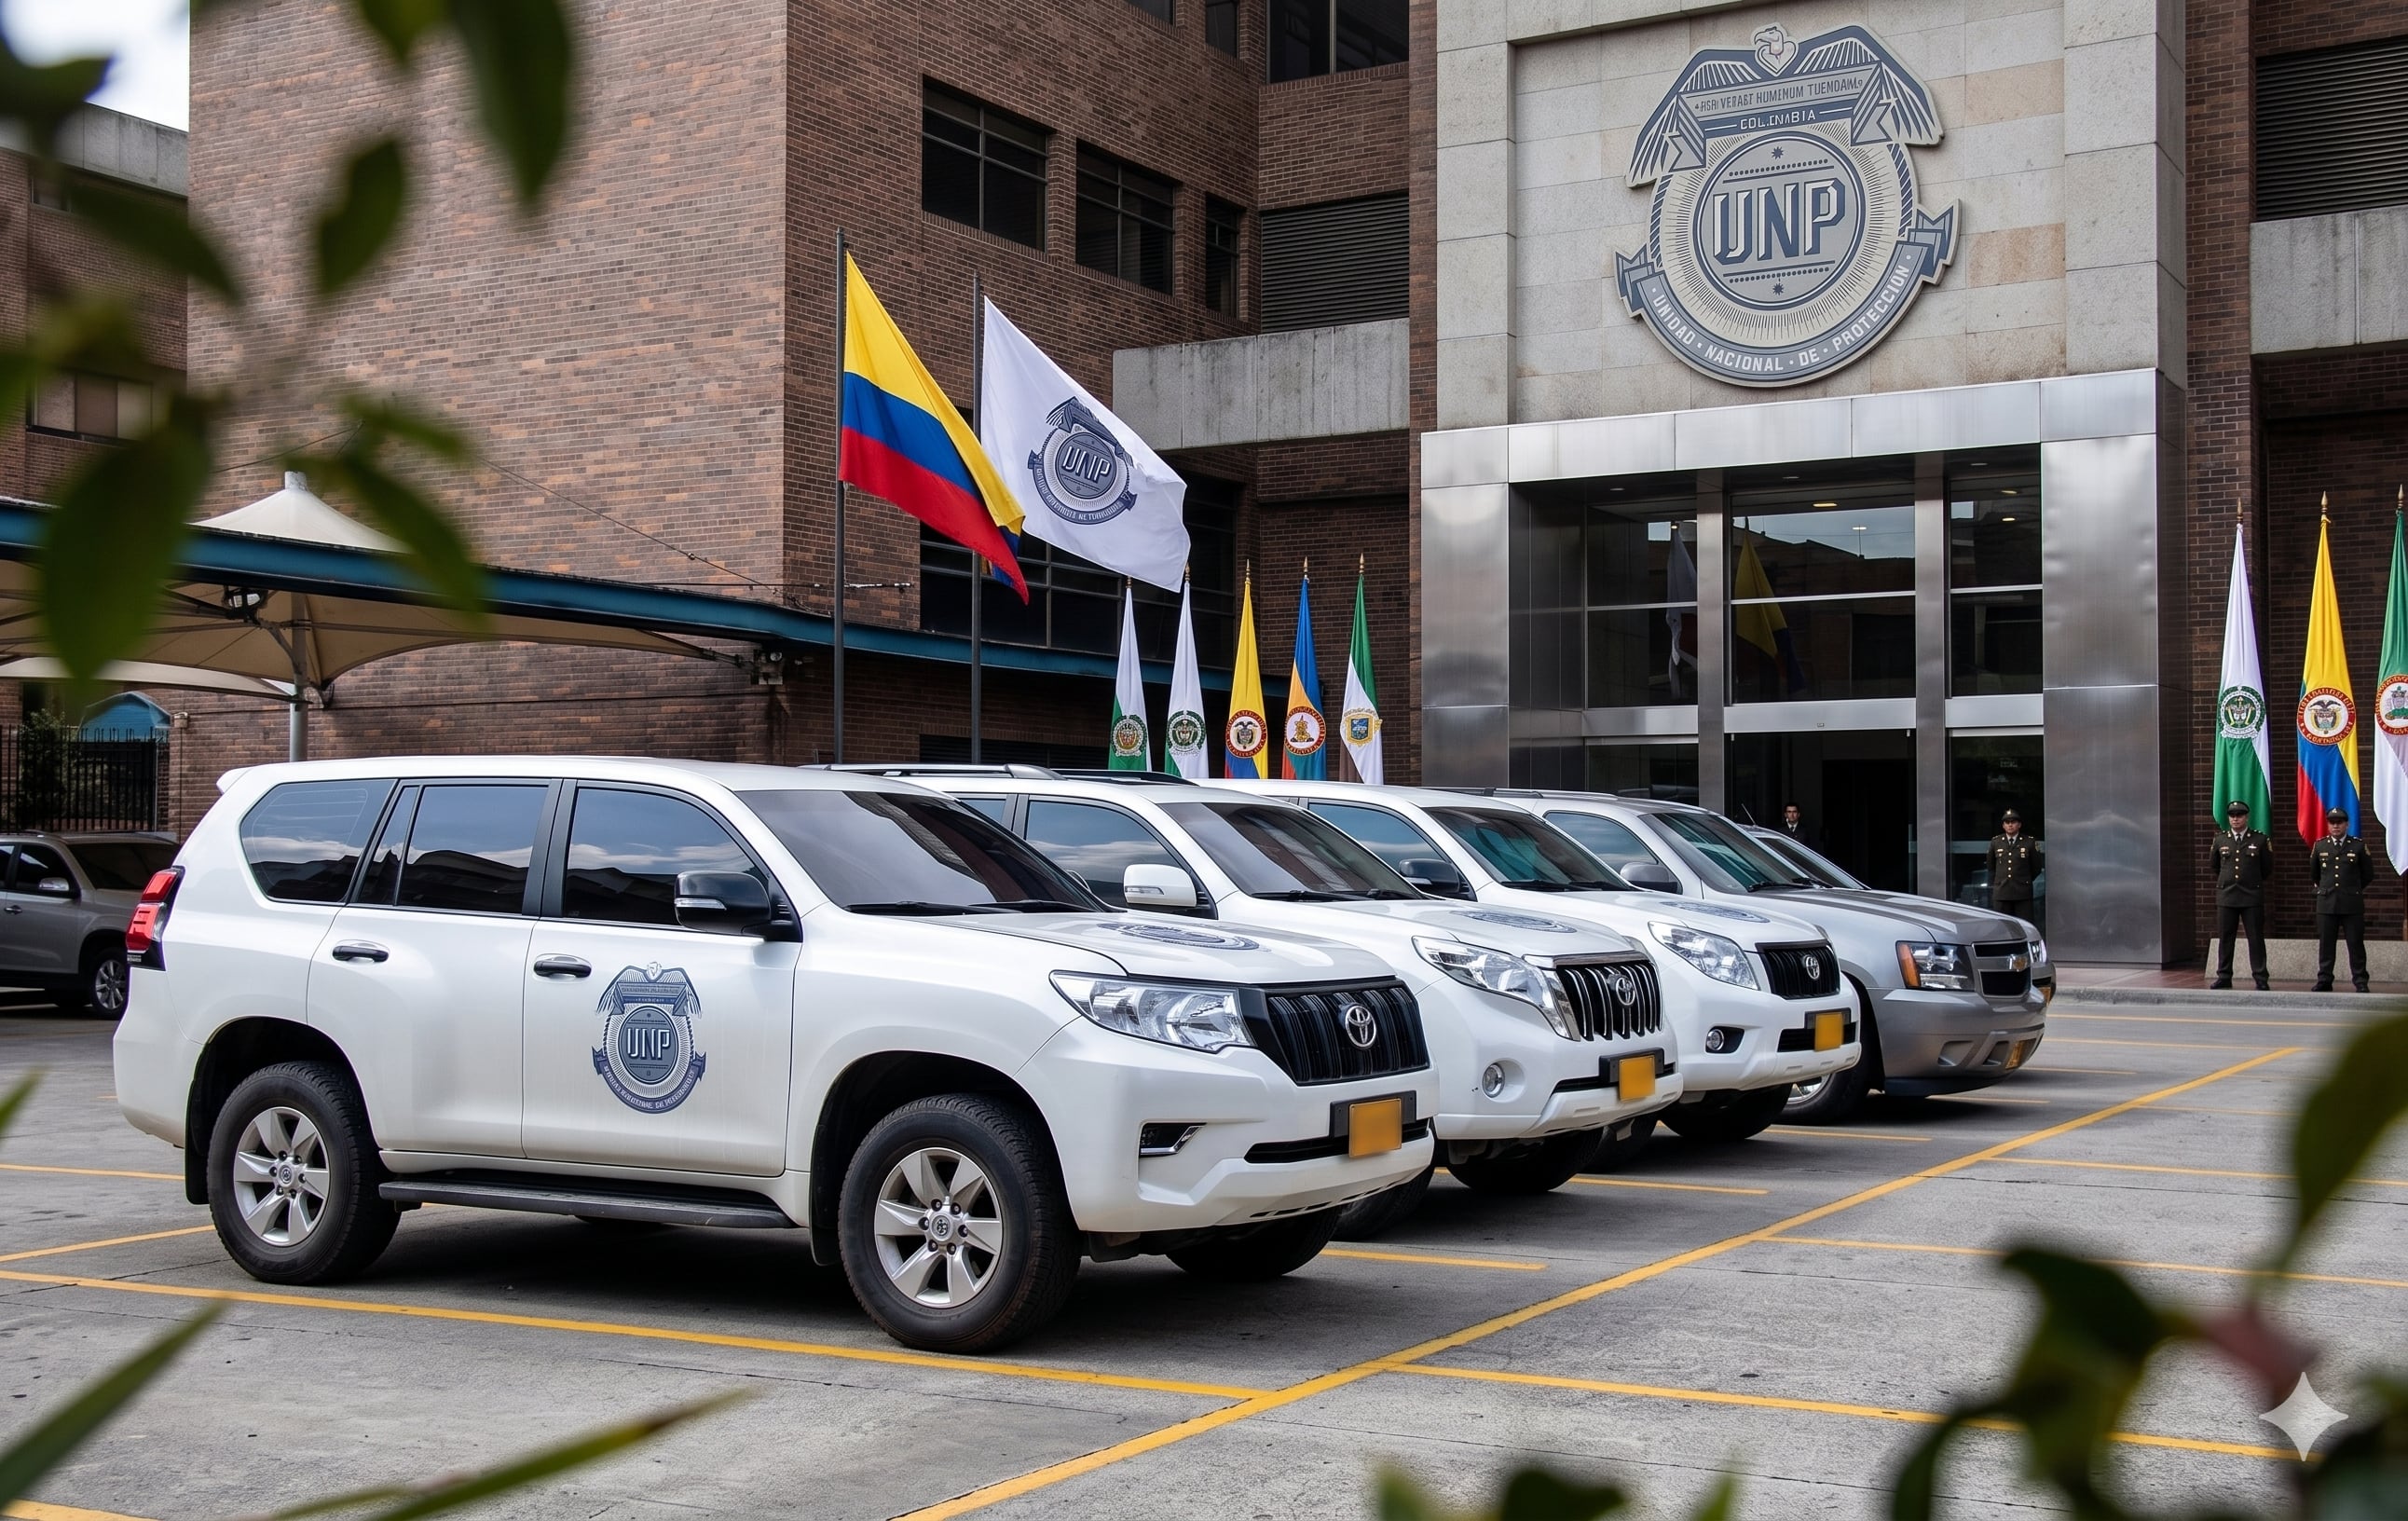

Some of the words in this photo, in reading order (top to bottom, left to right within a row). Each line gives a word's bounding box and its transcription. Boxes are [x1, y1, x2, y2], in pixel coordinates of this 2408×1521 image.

[1712, 177, 1845, 266] UNP
[1653, 294, 1696, 346] UNIDAD
[1704, 344, 1784, 372] NACIONAL
[1798, 348, 1820, 367] DE
[1062, 445, 1110, 483] UNP
[626, 1028, 671, 1061] UNP
